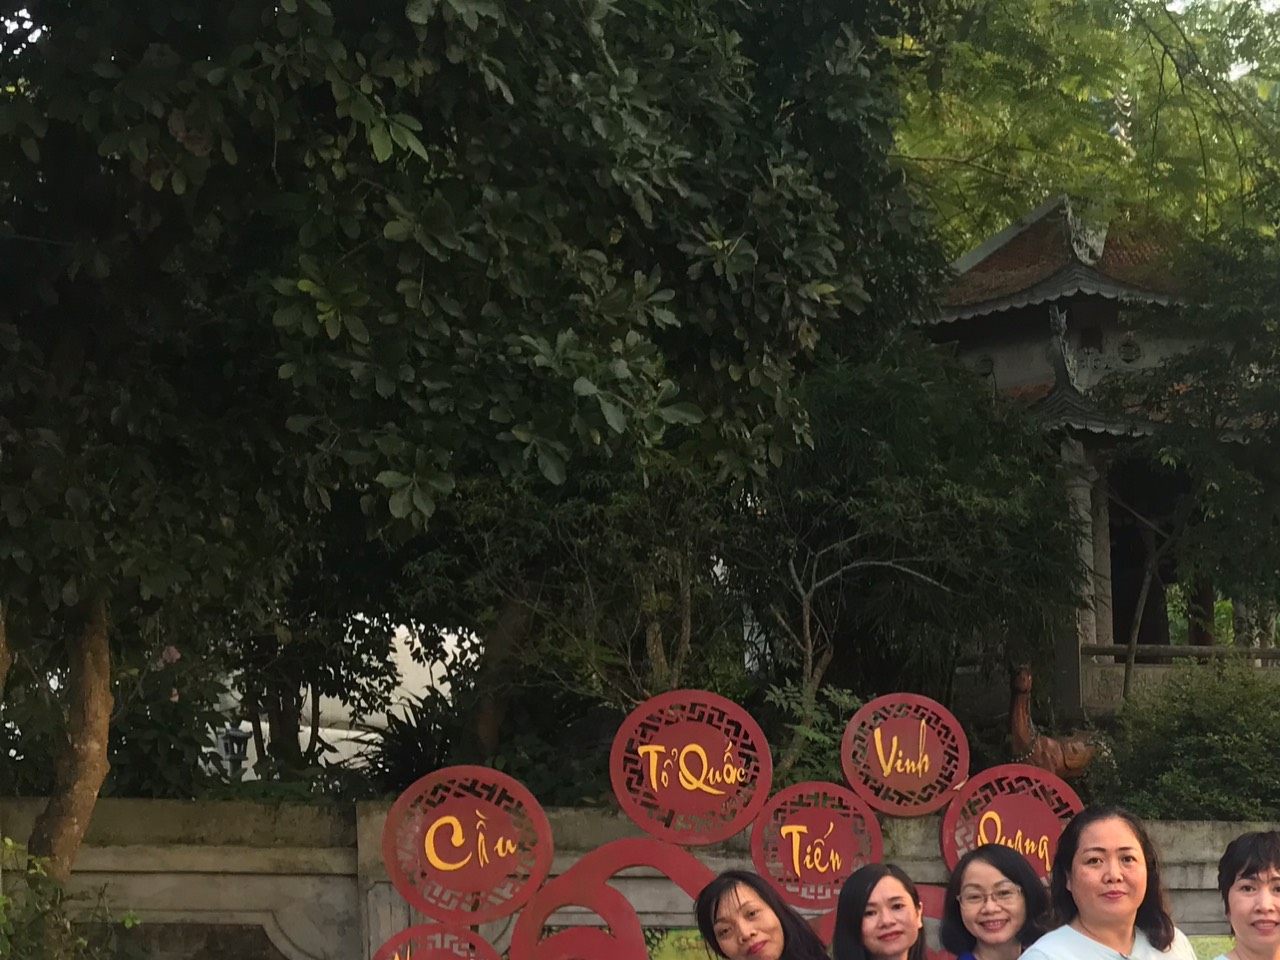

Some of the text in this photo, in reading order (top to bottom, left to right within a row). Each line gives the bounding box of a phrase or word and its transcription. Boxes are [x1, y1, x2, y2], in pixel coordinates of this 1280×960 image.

[637, 744, 678, 793] Tổ
[874, 718, 930, 778] Vinh
[424, 809, 517, 871] Cầu
[780, 821, 842, 878] Tiến
